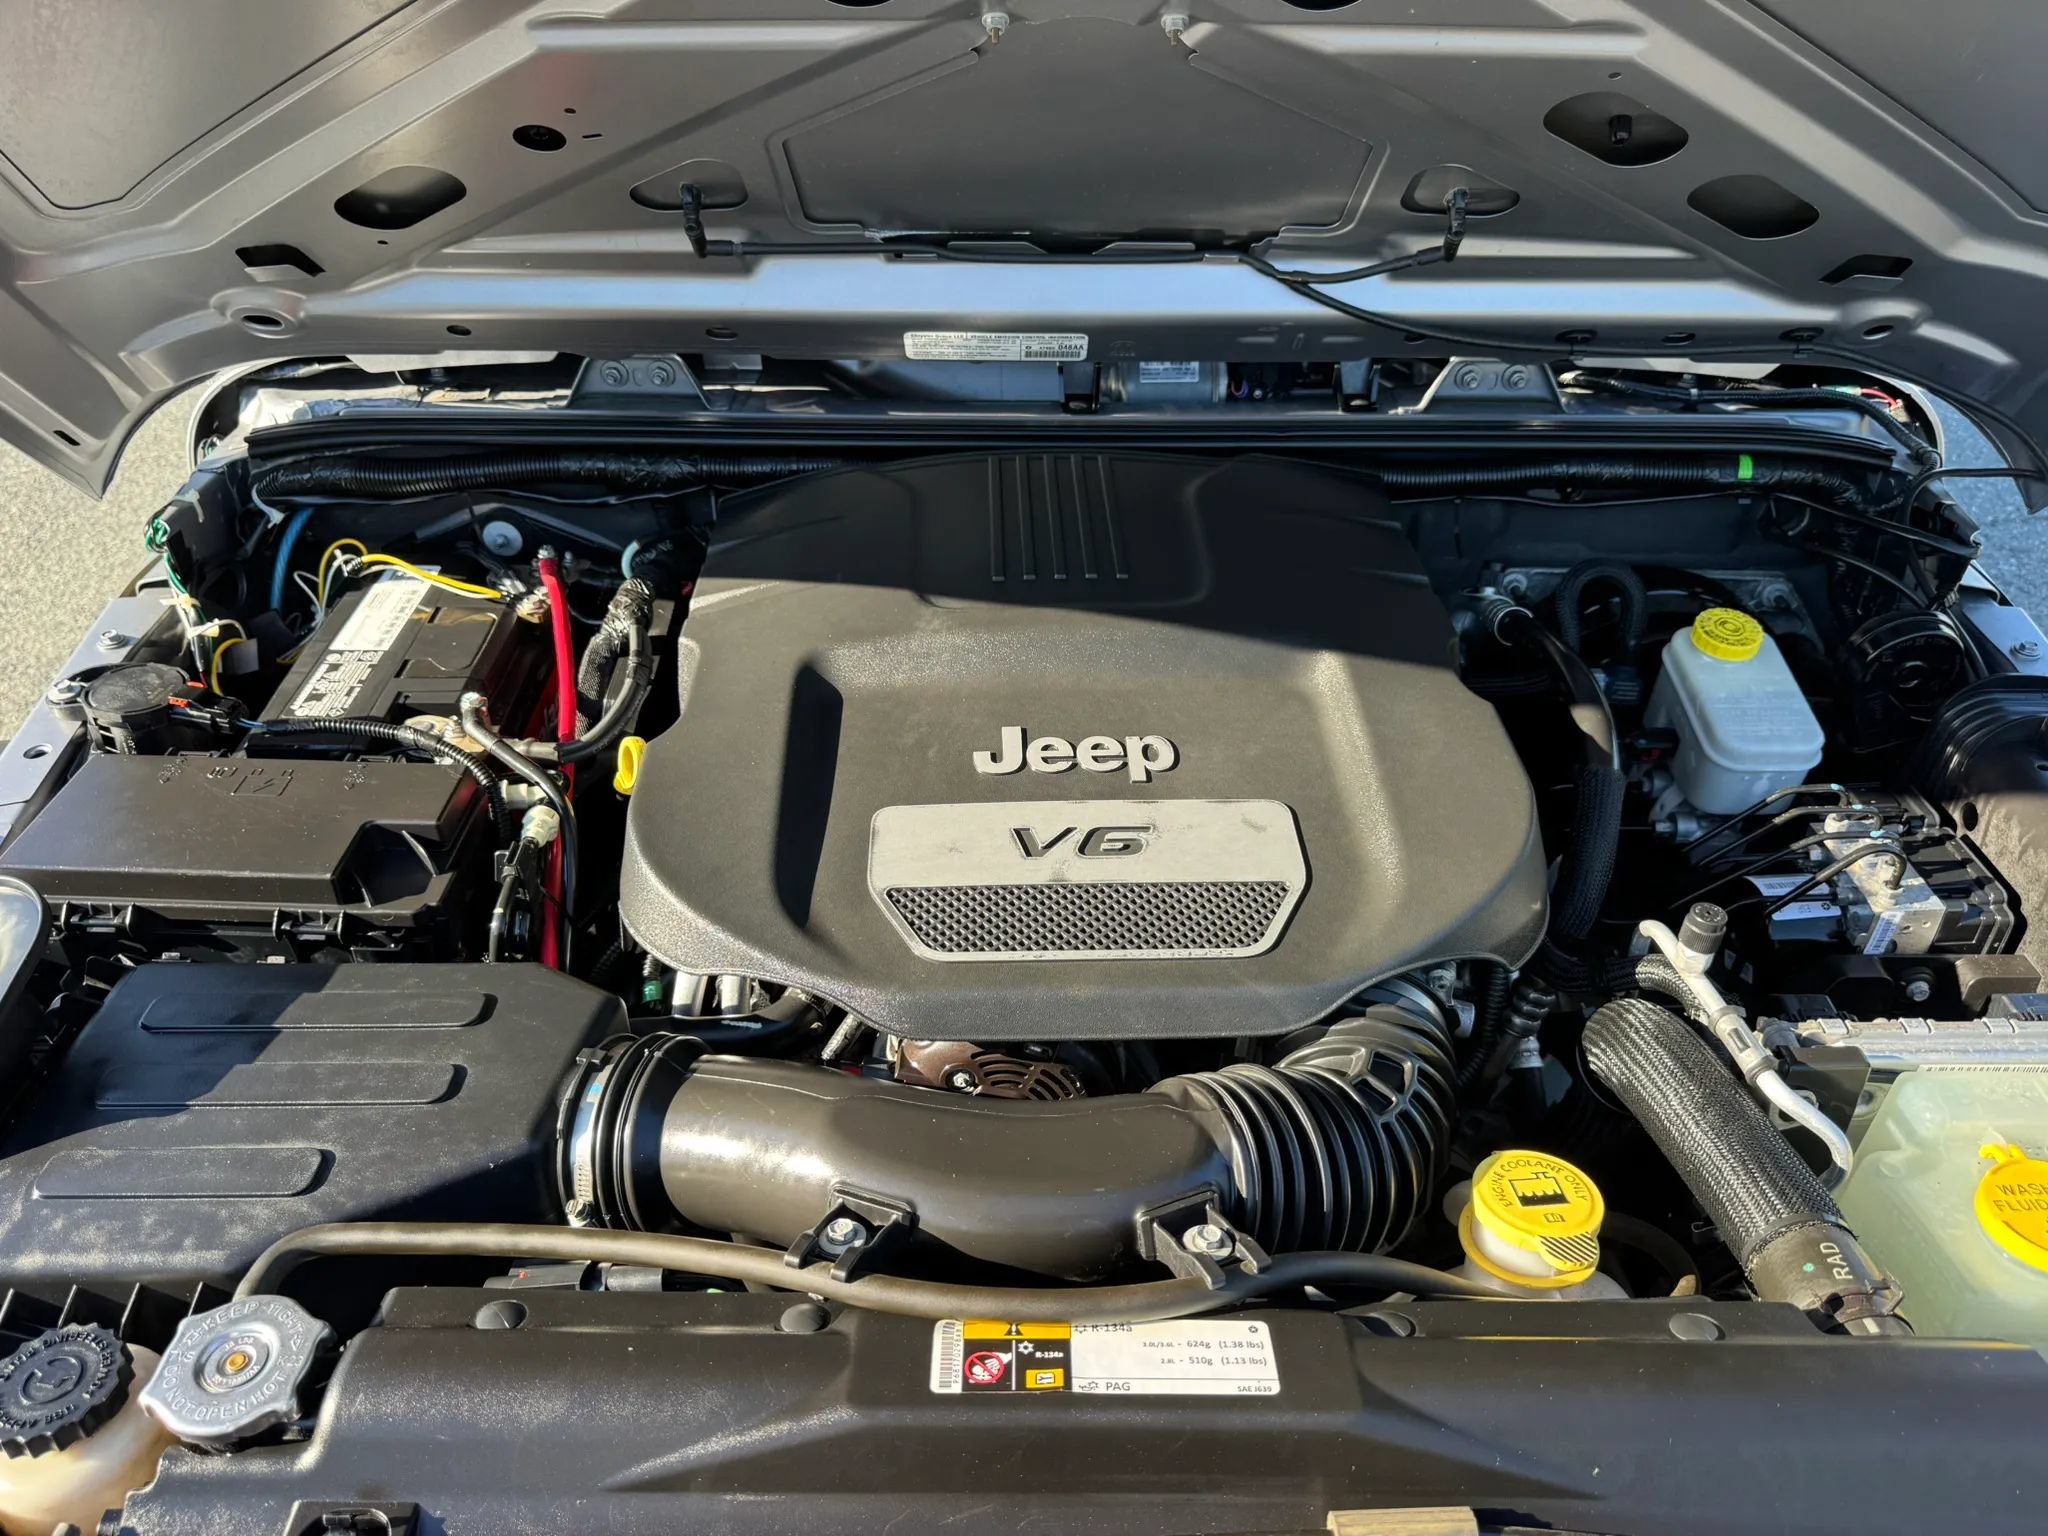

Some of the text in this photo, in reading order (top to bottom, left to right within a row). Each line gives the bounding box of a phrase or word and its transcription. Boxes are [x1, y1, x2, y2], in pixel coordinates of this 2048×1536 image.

[973, 726, 1175, 783] Jeep
[1011, 826, 1153, 858] V6
[1491, 1159, 1588, 1208] ENGINE COOLANT ONLY
[1993, 1199, 2048, 1212] FLUID
[1820, 1242, 1853, 1279] RAD
[203, 1303, 259, 1331] KEEP
[1186, 1340, 1211, 1349] 624g
[1218, 1340, 1244, 1350] (1.38
[1246, 1340, 1264, 1350] lbs)
[1188, 1356, 1213, 1366] 510g
[1221, 1357, 1246, 1367] (1.13
[1249, 1357, 1267, 1367] lbs)
[163, 1364, 180, 1388] DO
[250, 1371, 287, 1406] HOT
[1106, 1382, 1131, 1391] PAG
[165, 1387, 196, 1415] NOT
[199, 1400, 249, 1421] OPEN
